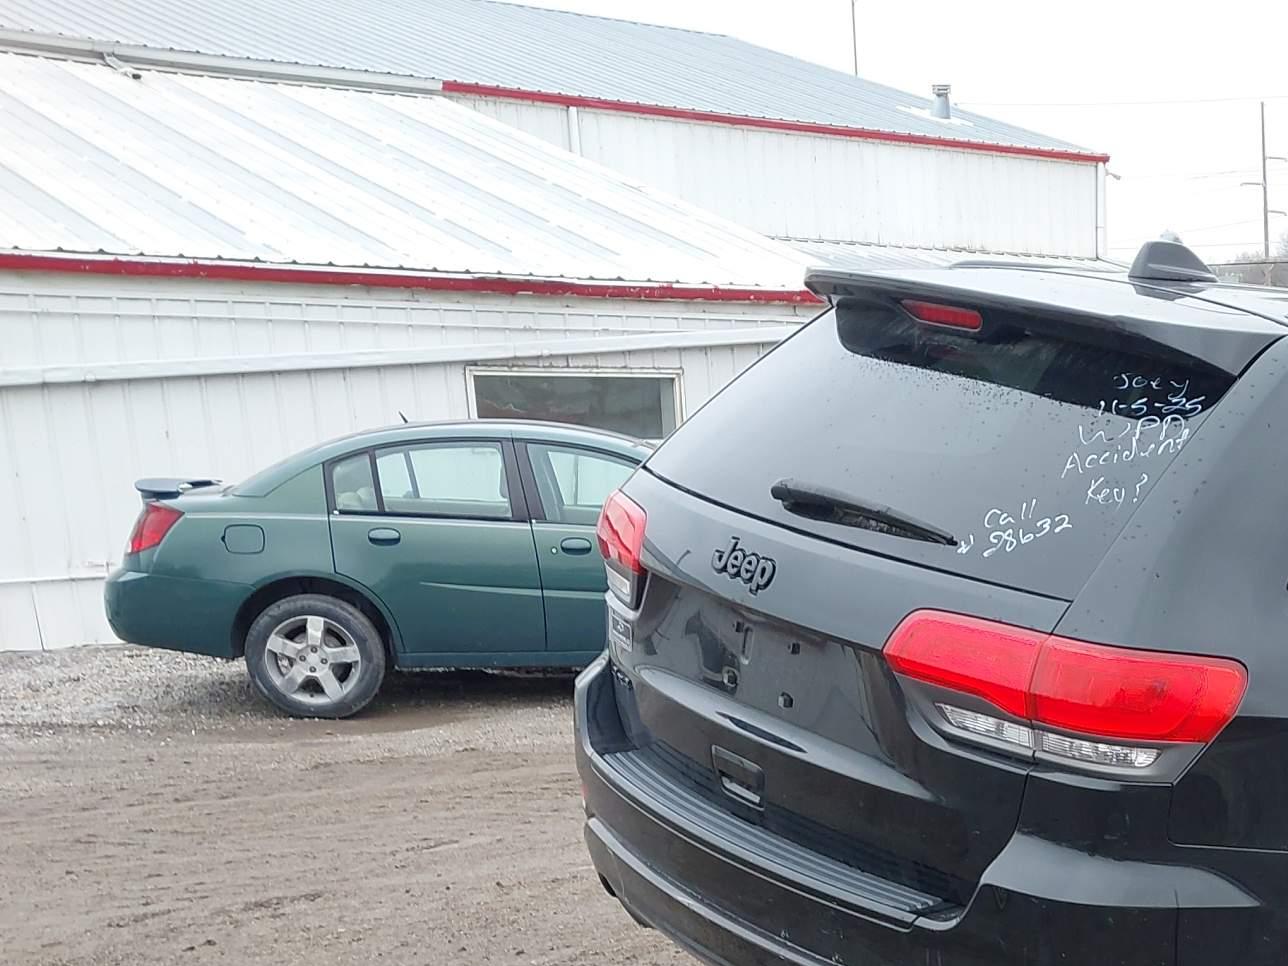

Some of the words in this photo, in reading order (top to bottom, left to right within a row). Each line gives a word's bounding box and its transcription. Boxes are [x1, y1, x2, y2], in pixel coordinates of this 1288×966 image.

[1060, 428, 1190, 479] Accident
[984, 499, 1036, 528] Call
[711, 536, 776, 595] Jeep
